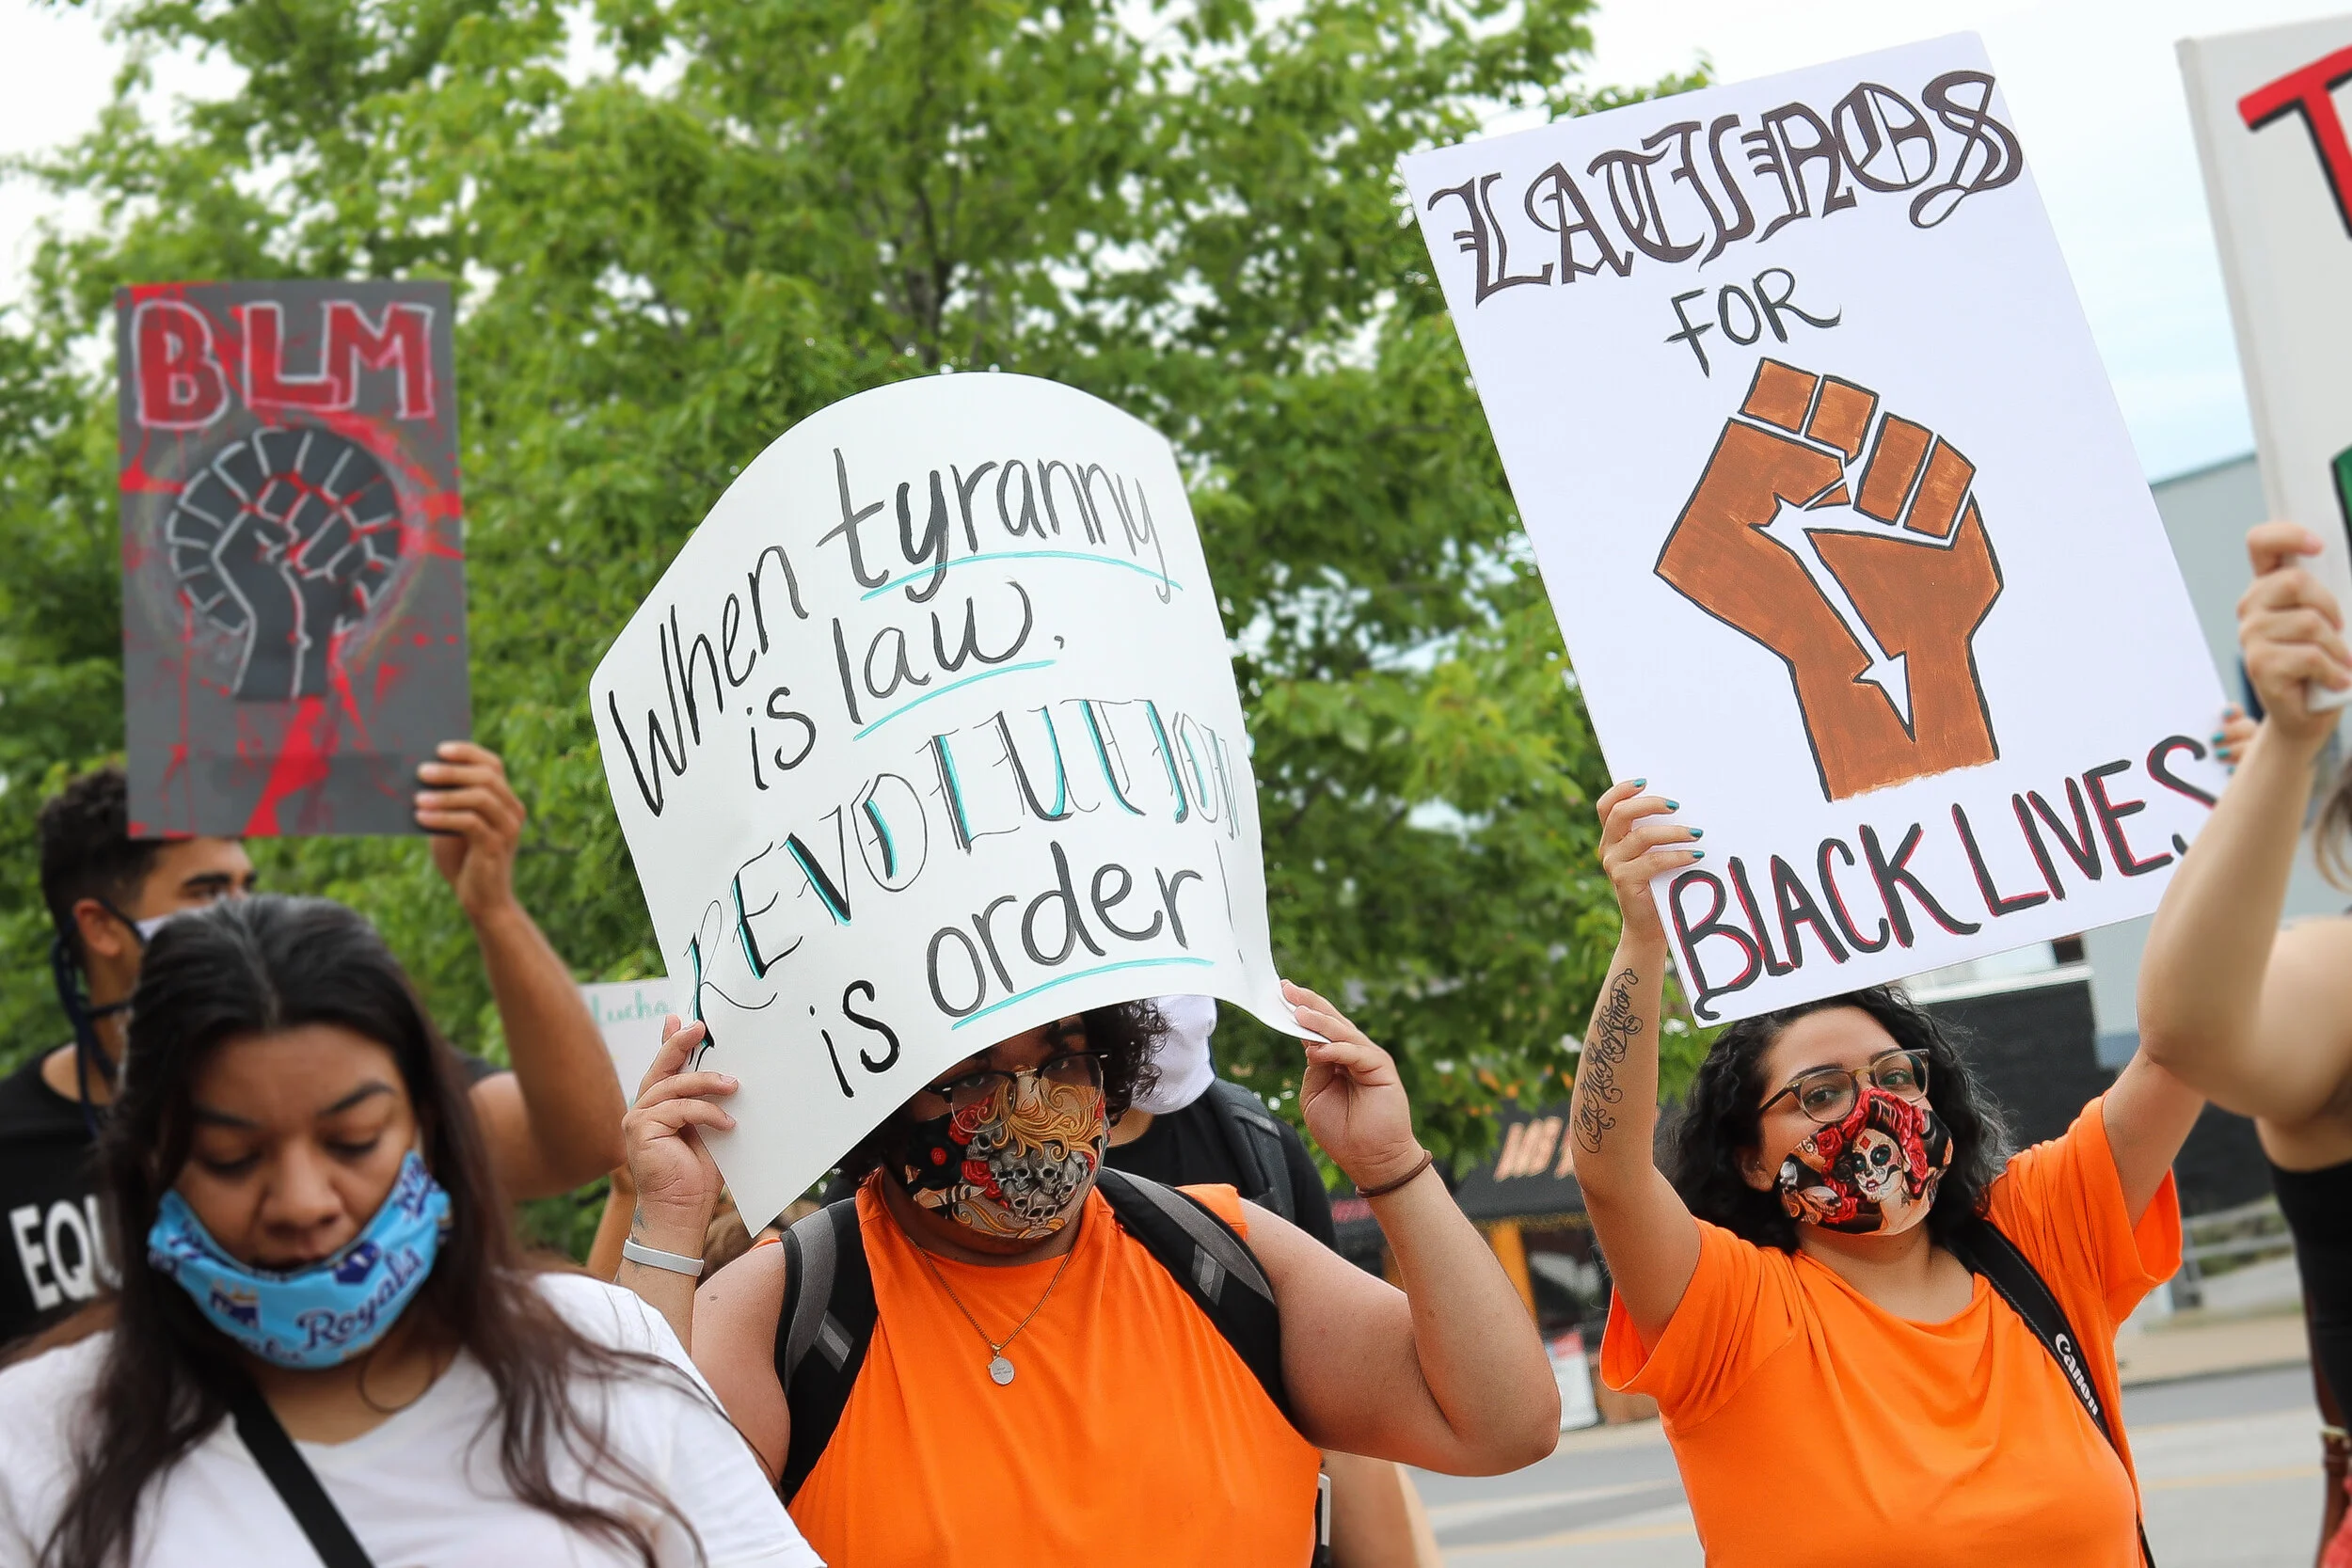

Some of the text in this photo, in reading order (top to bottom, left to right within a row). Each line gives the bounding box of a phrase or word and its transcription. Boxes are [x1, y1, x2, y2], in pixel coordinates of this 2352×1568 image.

[1427, 70, 2024, 309] LATINOS
[130, 298, 437, 430] BLM
[1663, 267, 1842, 378] FOR
[608, 447, 1172, 818] When tyranny
[745, 687, 818, 791] is
[683, 698, 1242, 1072] REVOLUTION
[1668, 735, 2218, 1022] BLACK LIVES
[807, 979, 902, 1099] is
[294, 1243, 426, 1351] Royals
[2055, 1332, 2100, 1417] Canon
